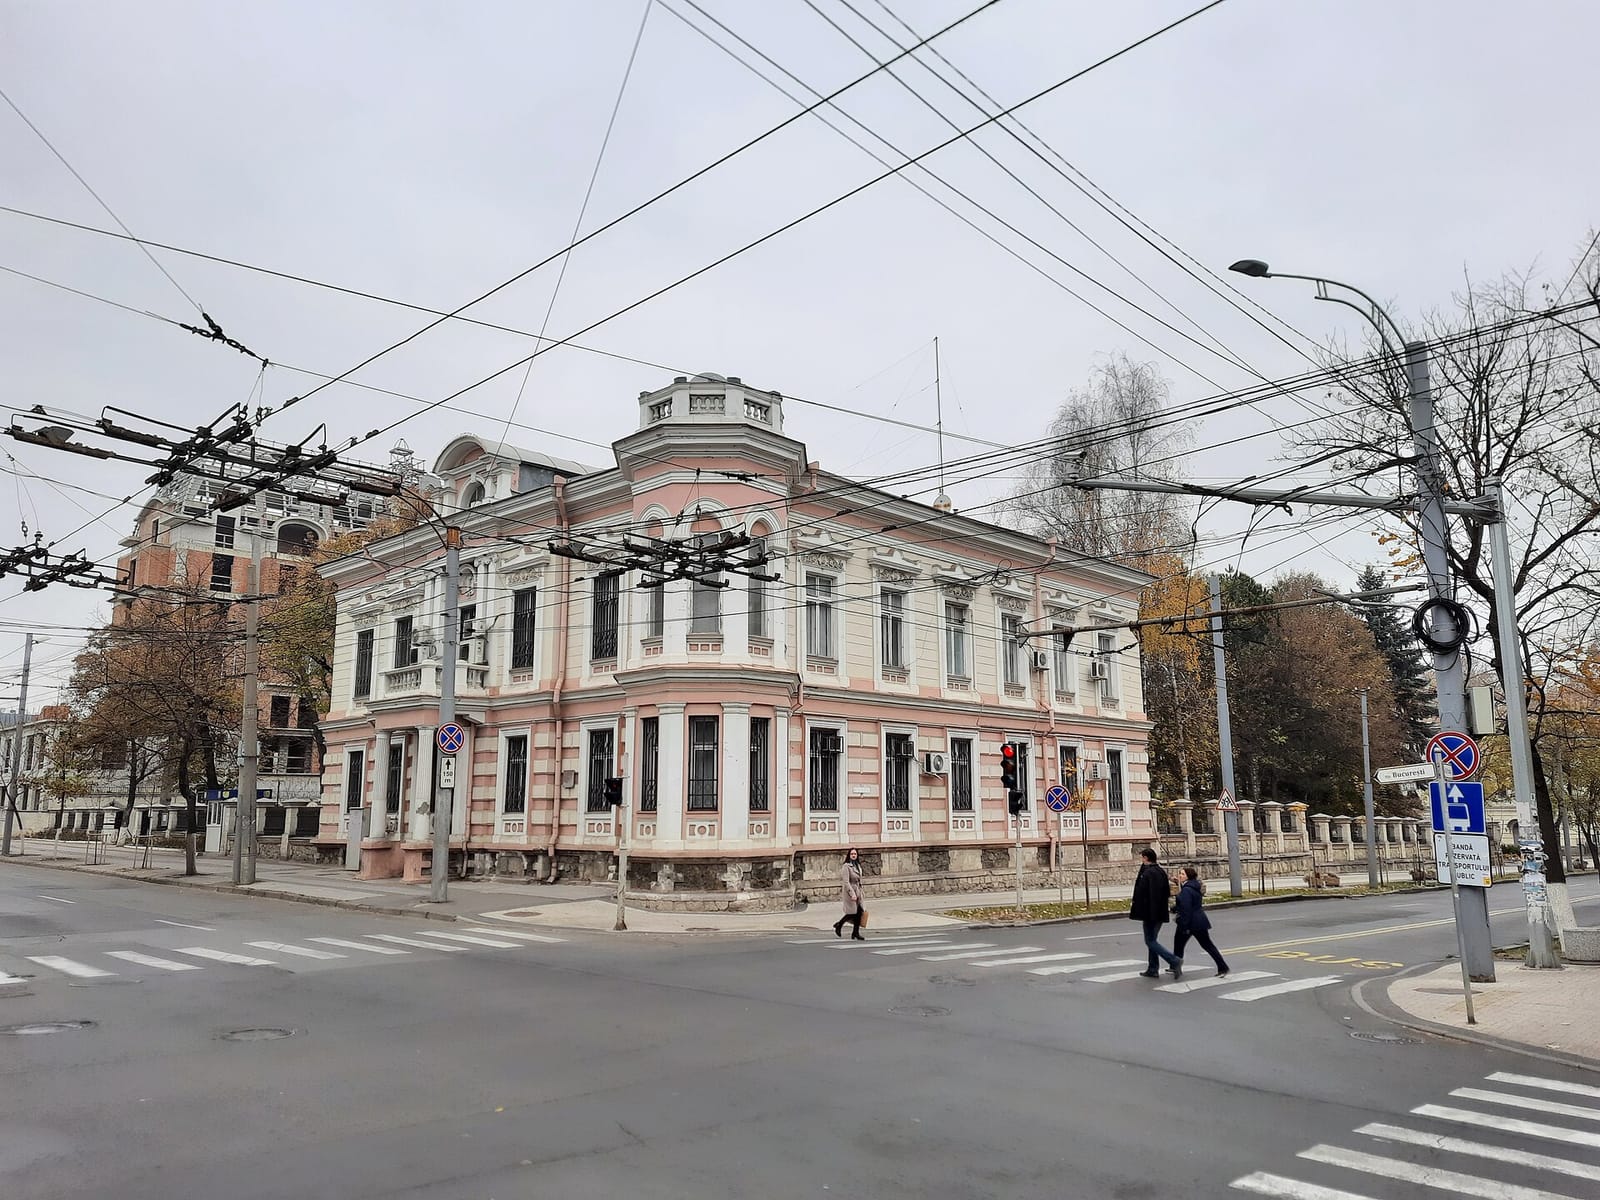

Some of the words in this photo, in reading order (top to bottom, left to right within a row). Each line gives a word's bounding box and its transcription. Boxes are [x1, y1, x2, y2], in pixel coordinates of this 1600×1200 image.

[1445, 853, 1481, 861] RZERVATĂ
[1438, 861, 1490, 871] TRASPORTULUI
[1256, 950, 1404, 969] BUS
